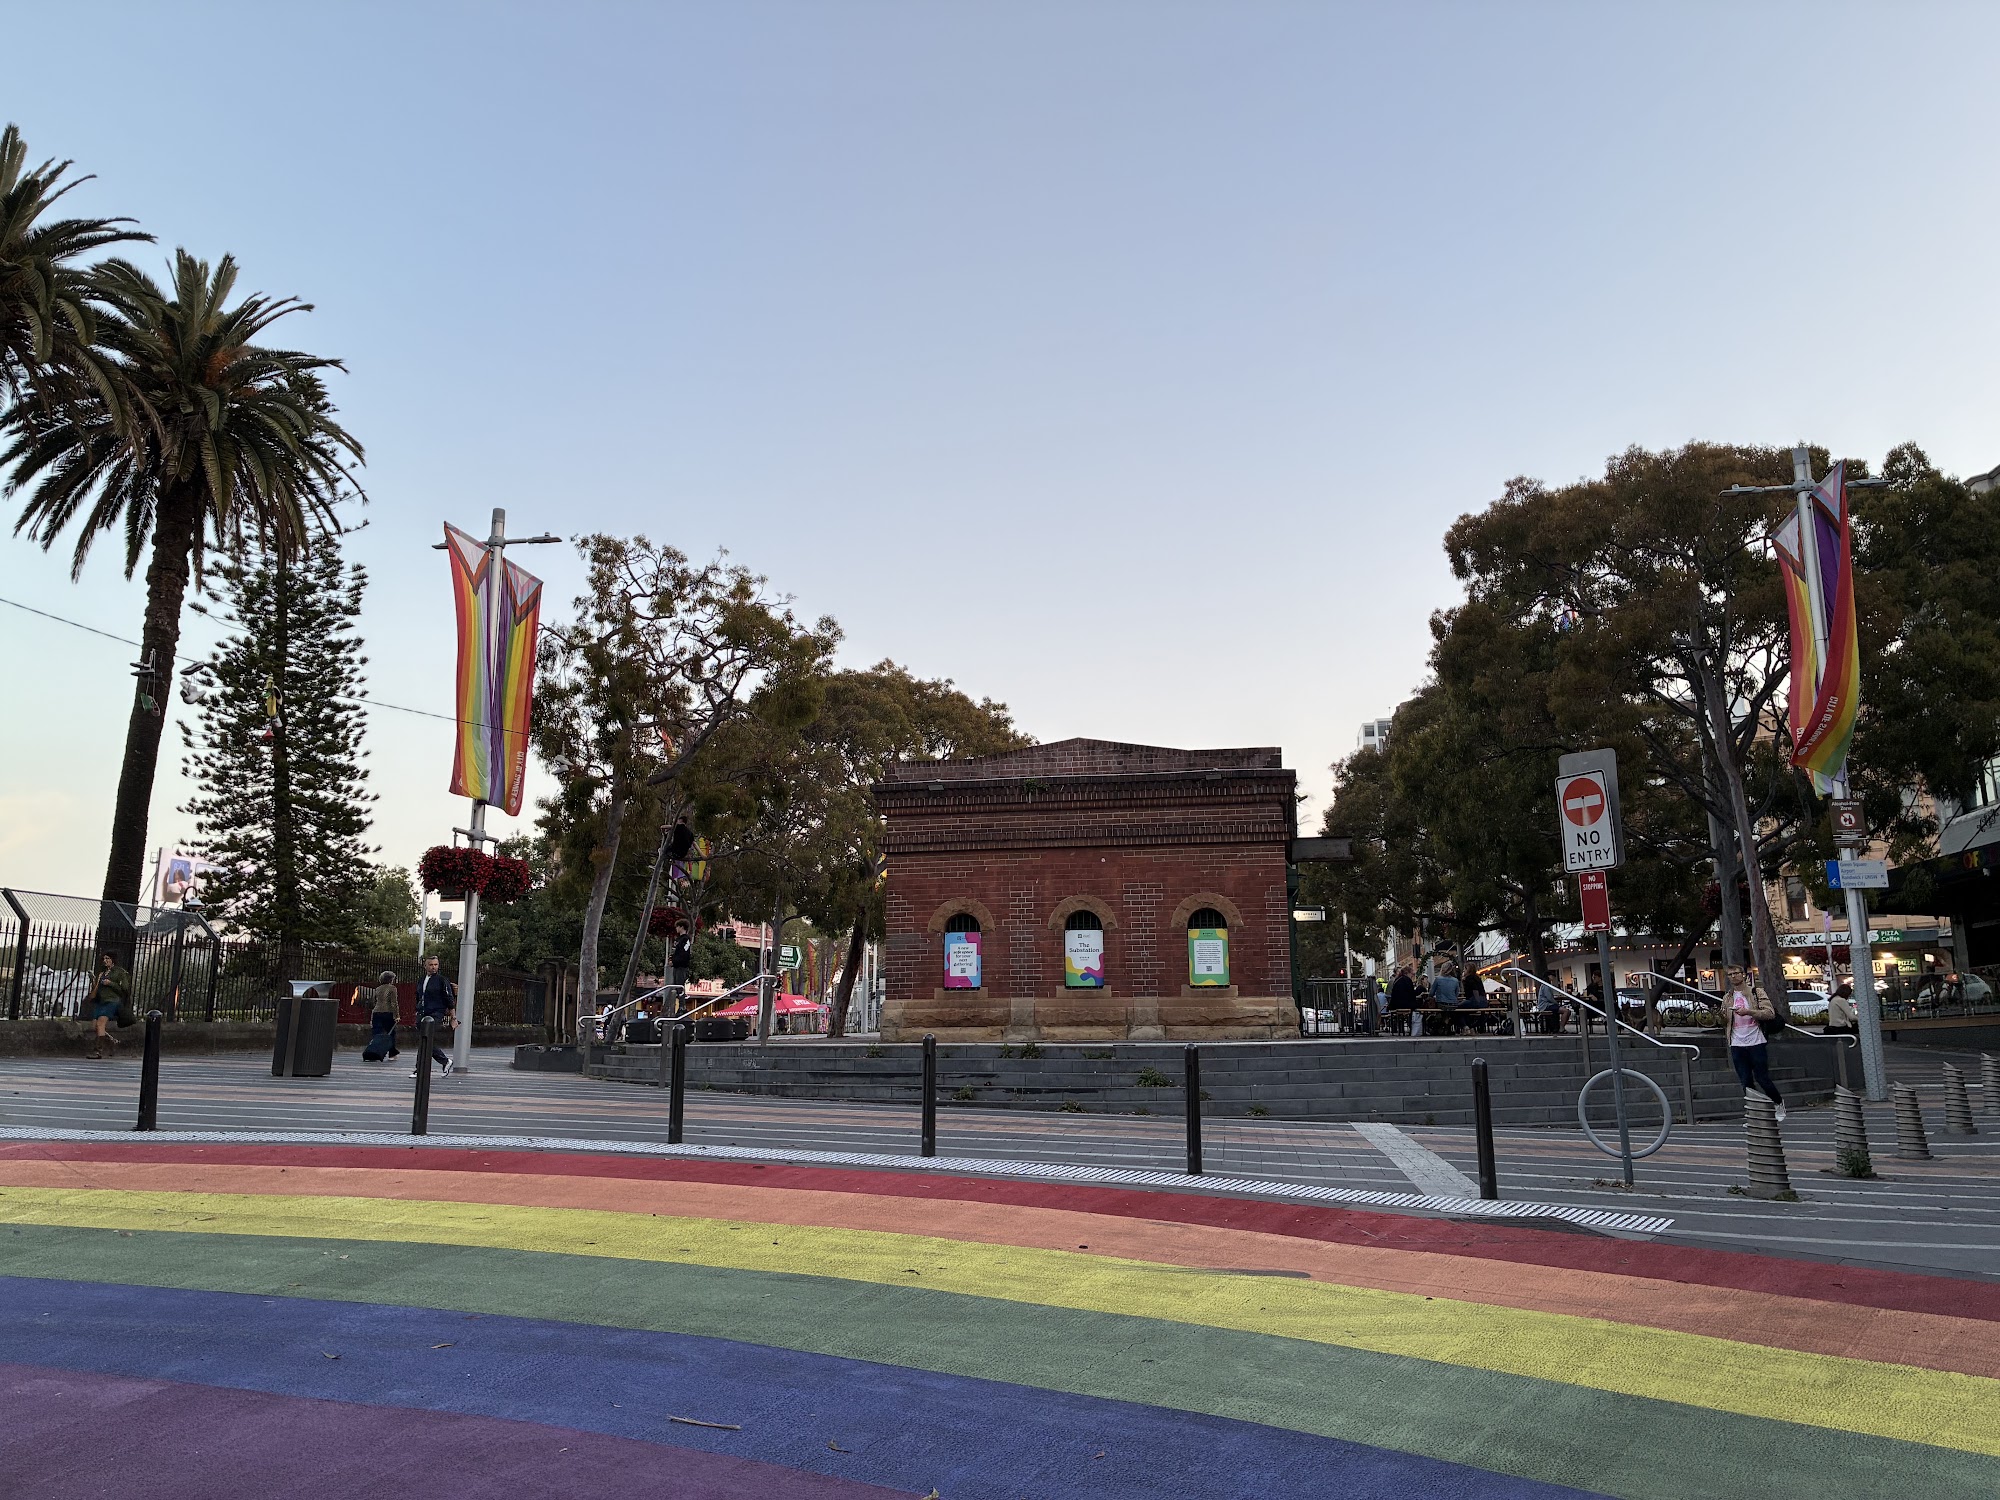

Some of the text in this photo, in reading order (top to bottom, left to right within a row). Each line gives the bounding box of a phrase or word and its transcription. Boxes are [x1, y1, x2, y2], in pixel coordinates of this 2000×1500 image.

[511, 774, 521, 797] SYDNEY
[1576, 830, 1601, 847] NO
[1569, 847, 1611, 865] ENTRY
[1582, 882, 1604, 891] STOPPING
